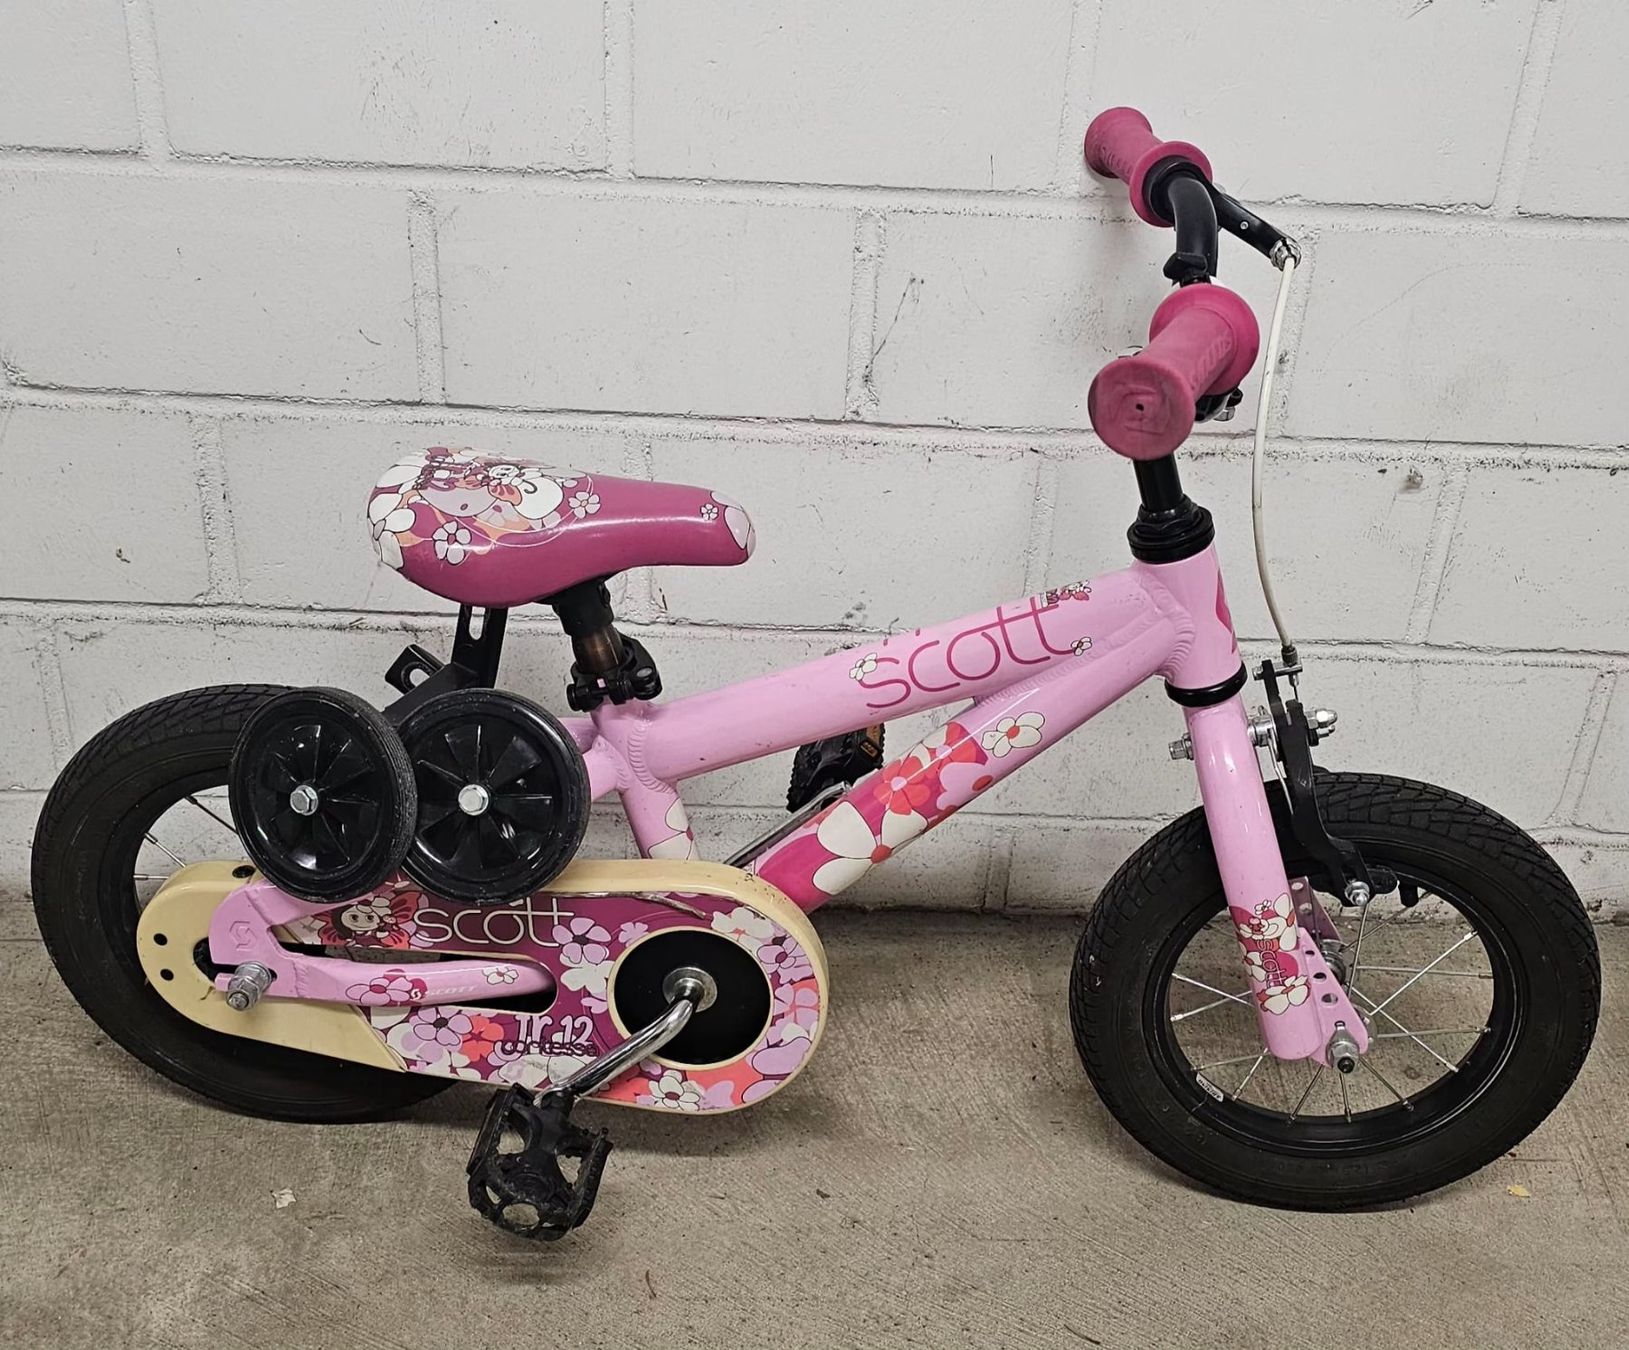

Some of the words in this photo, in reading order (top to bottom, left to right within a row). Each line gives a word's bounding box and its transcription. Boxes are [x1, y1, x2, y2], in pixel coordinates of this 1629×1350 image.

[856, 596, 1075, 708] scott
[413, 896, 574, 947] scott
[559, 1014, 594, 1045] 12
